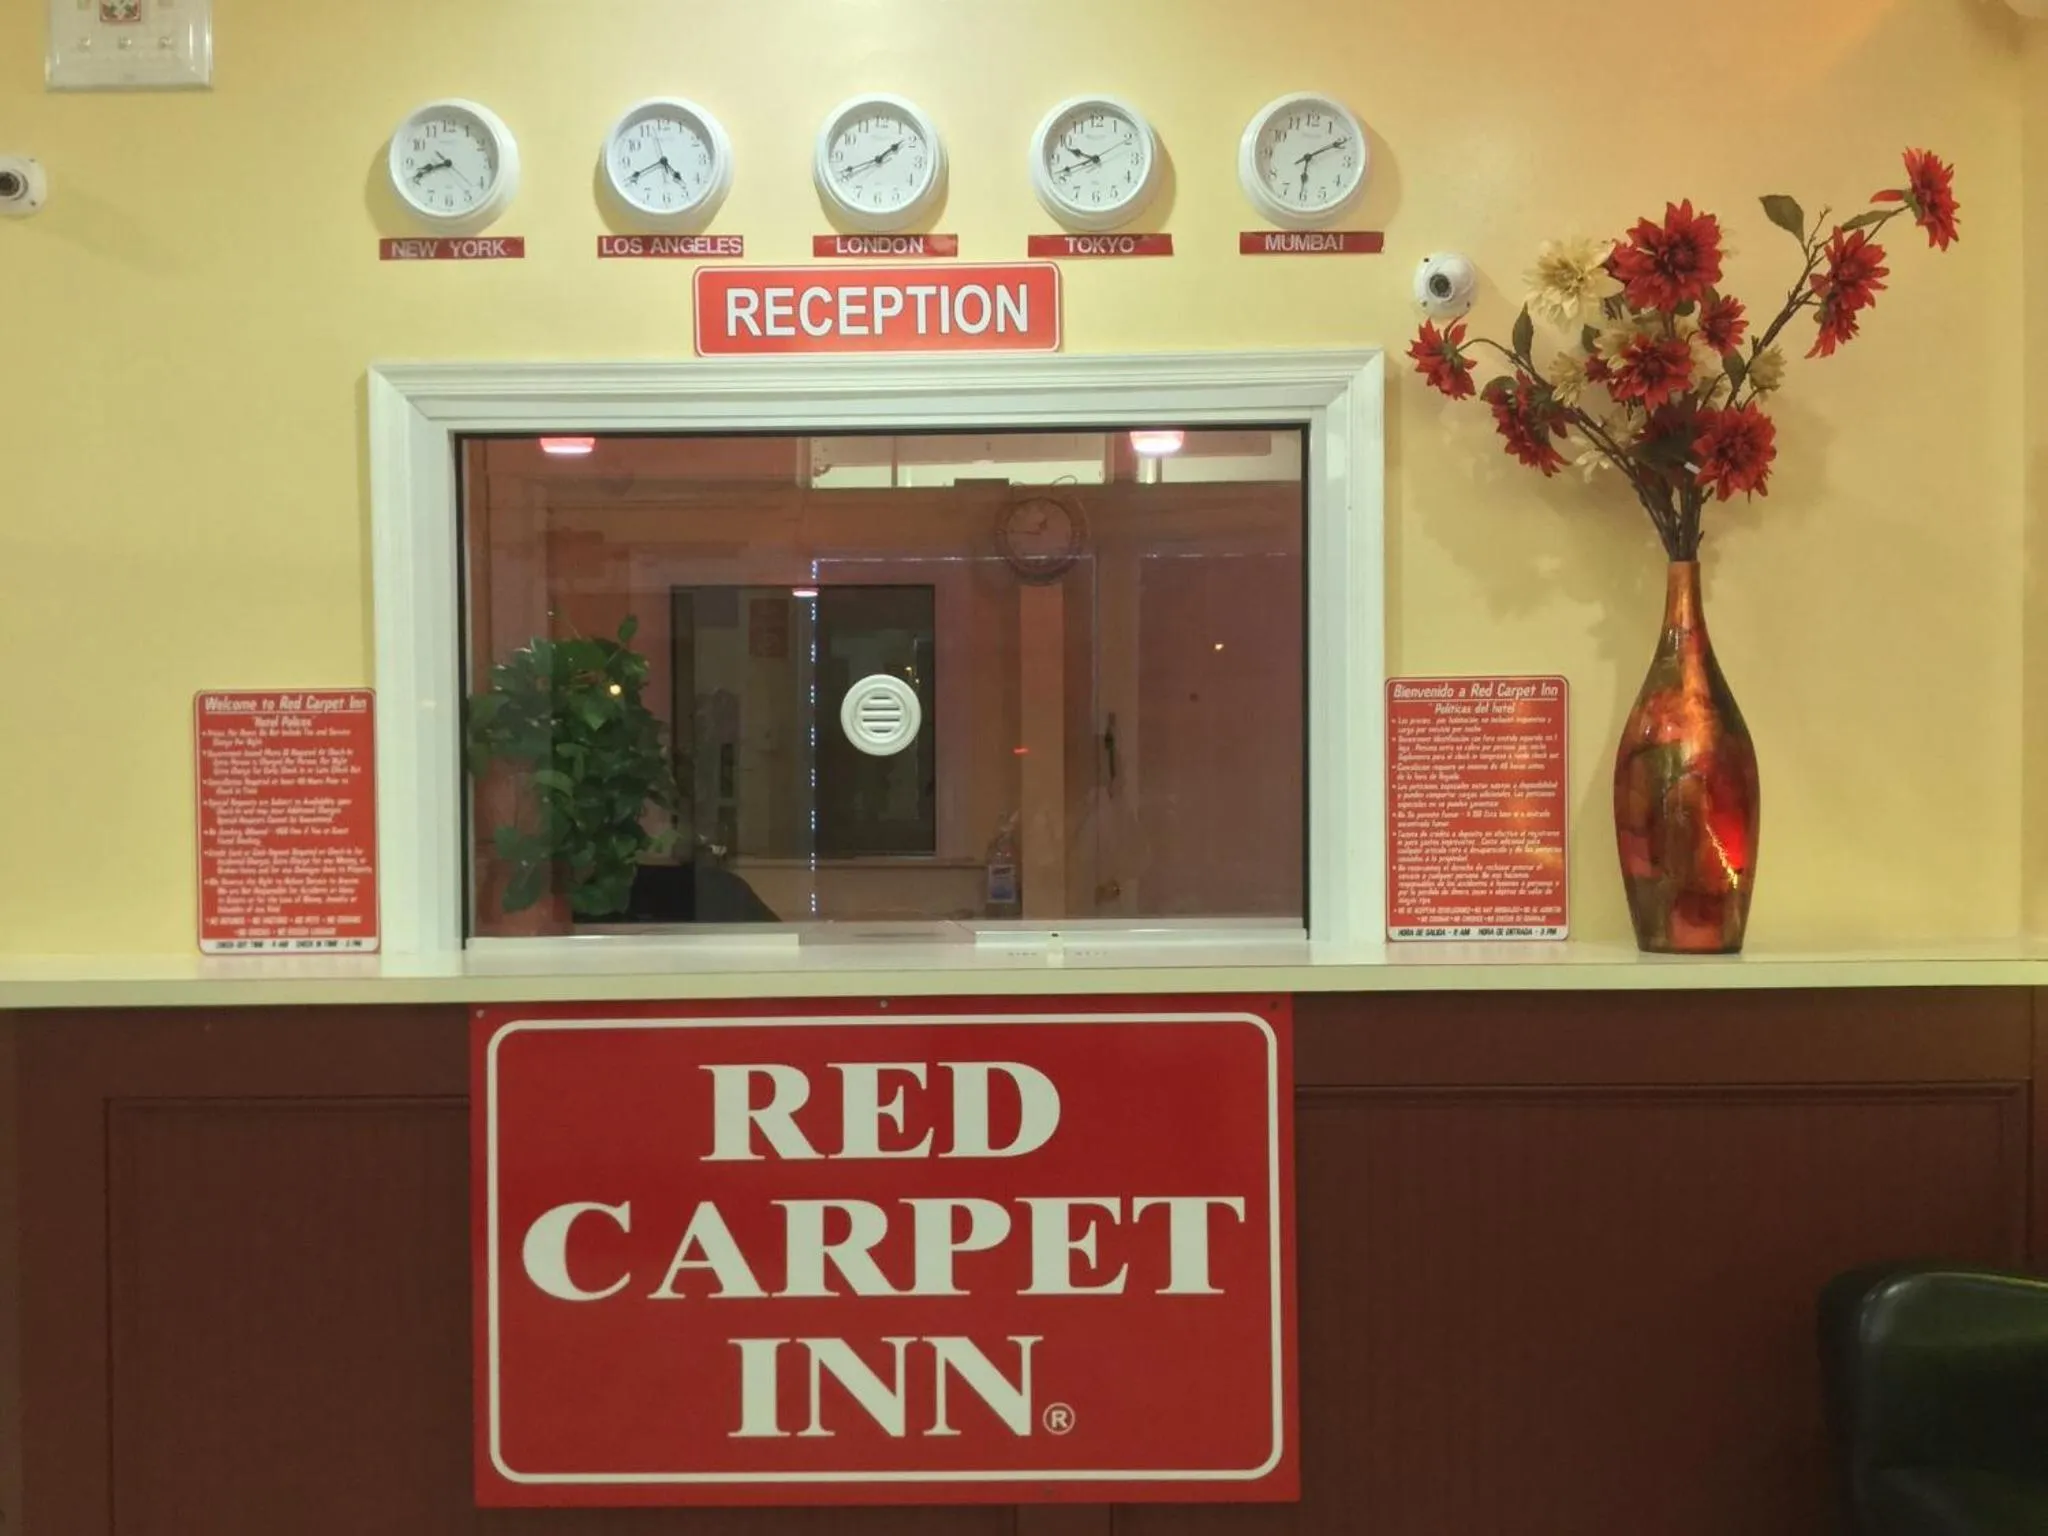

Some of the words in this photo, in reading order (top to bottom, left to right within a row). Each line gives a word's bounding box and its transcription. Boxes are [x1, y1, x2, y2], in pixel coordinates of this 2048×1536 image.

[391, 240, 437, 258] NEW
[450, 239, 506, 257] YORK
[602, 236, 643, 256] LOS
[649, 236, 743, 255] ANGELES
[836, 236, 925, 254] LONDON
[1065, 236, 1135, 254] TOKYO
[1265, 234, 1345, 252] MUMBAI
[726, 284, 1029, 338] RECEPTION
[1393, 683, 1454, 698] Bienvenido
[1458, 687, 1466, 698] a
[1471, 682, 1494, 697] Red
[1498, 682, 1536, 701] Carpet
[1541, 681, 1559, 697] Inn
[205, 696, 257, 711] Welcome
[262, 697, 275, 710] to
[280, 695, 302, 710] Red
[306, 695, 345, 713] Carpet
[349, 695, 367, 710] Inn
[699, 1060, 1062, 1162] RED
[521, 1196, 1246, 1302] CARPET
